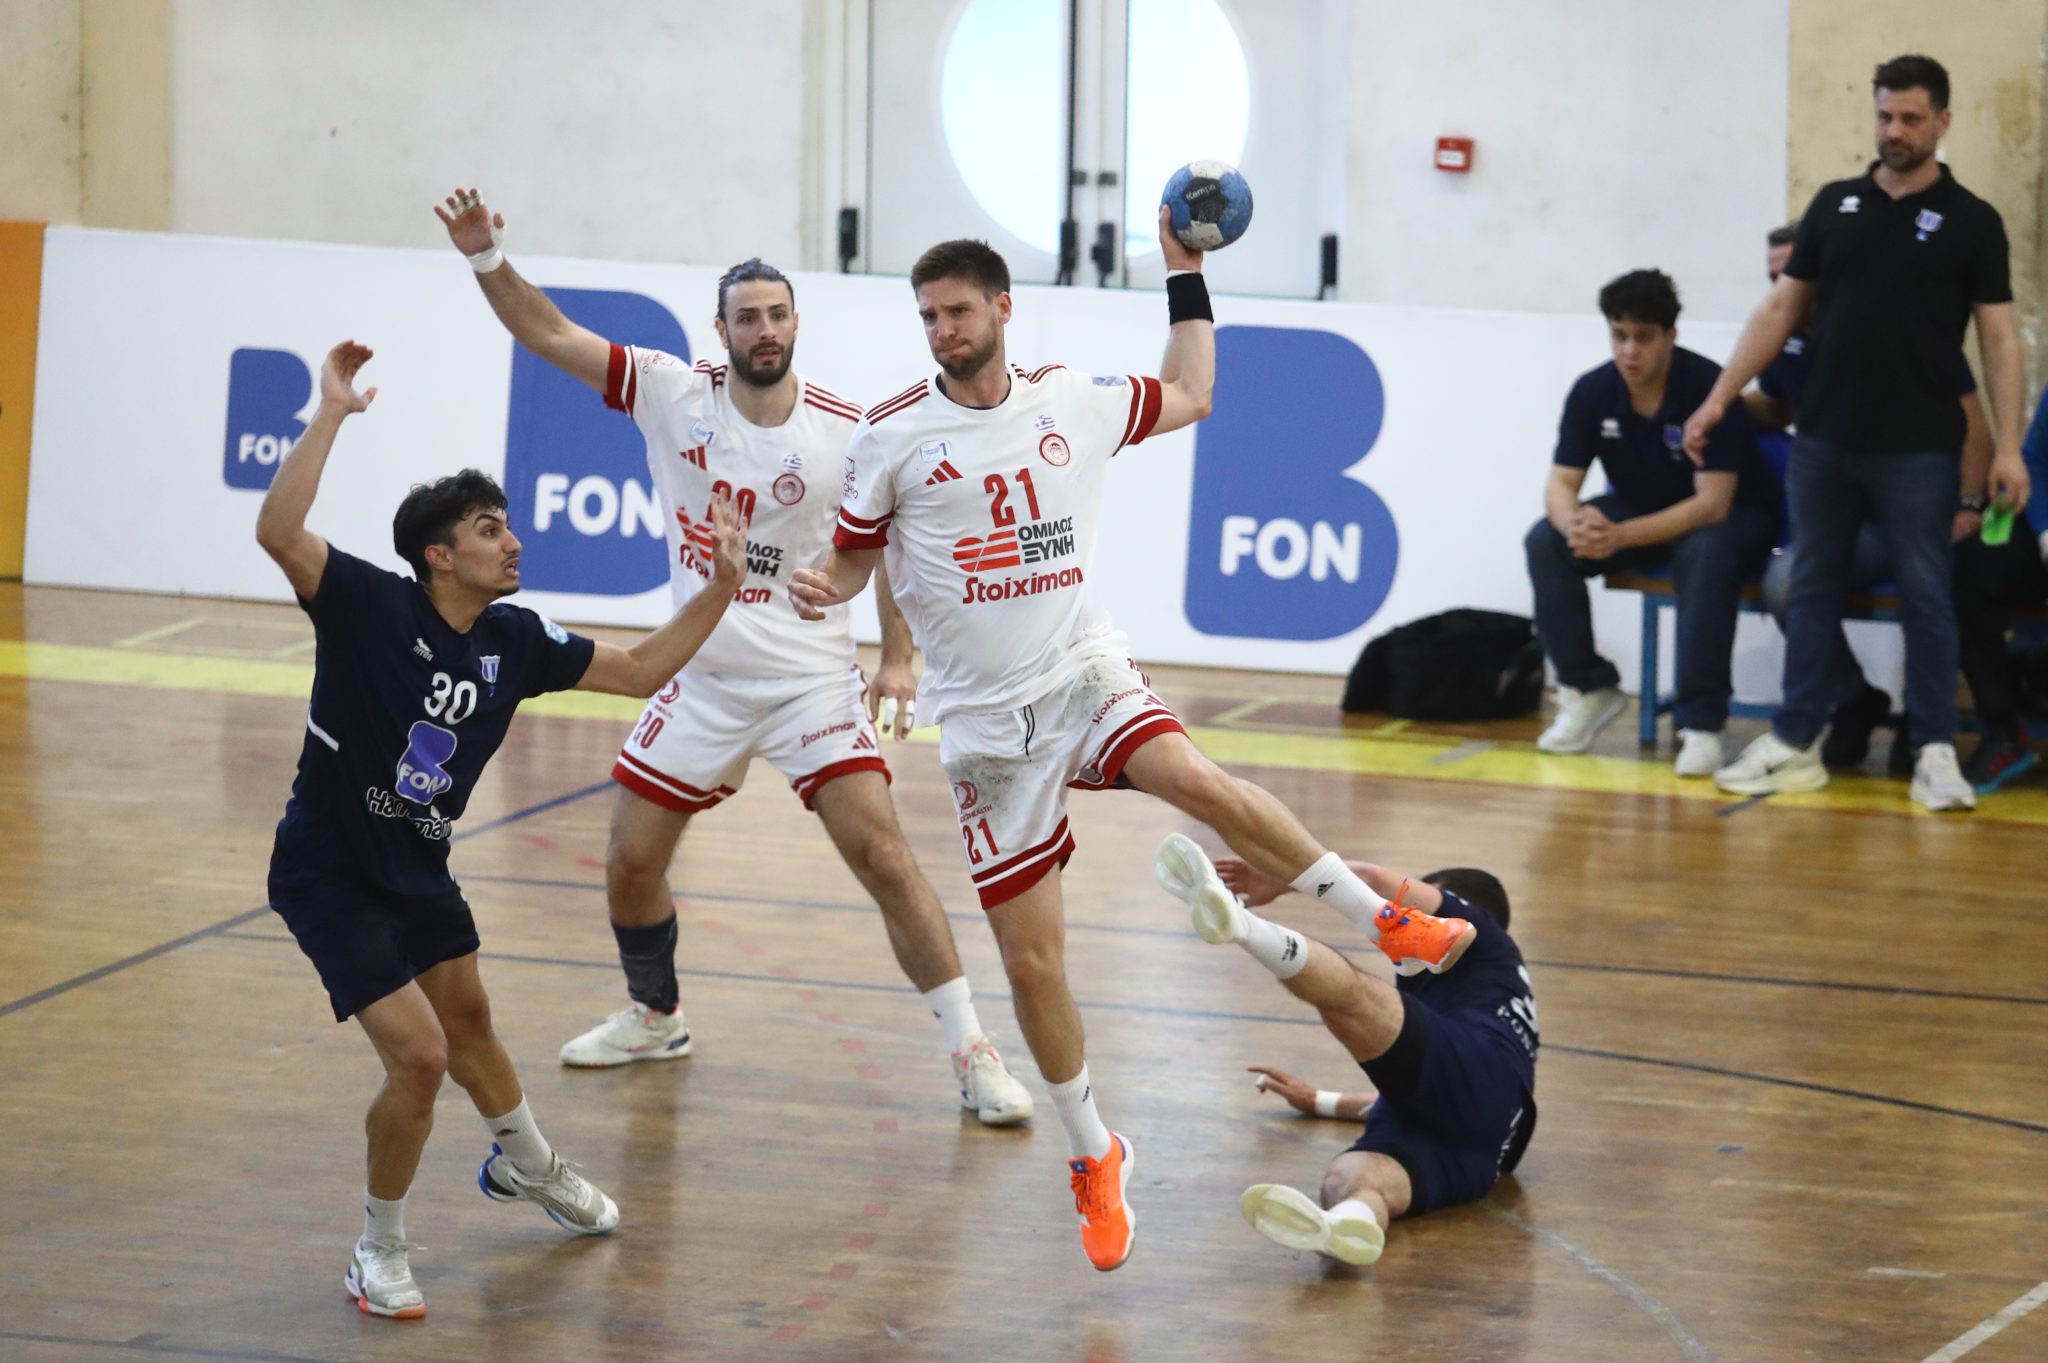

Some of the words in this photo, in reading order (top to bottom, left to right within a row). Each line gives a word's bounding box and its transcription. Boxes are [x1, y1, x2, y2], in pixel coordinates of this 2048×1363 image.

[533, 472, 667, 541] FON
[984, 467, 1041, 529] 21
[1018, 516, 1073, 542] ΟΜΙΛΟΣ
[745, 539, 784, 562] ΙΛΟΣ
[1022, 533, 1075, 564] ΞΥΝΗ
[1219, 514, 1364, 585] FON
[962, 566, 1084, 604] Stoiximan
[424, 671, 478, 725] 30
[801, 721, 857, 749] Stoiximan
[399, 763, 447, 794] FON
[962, 817, 1000, 866] 21
